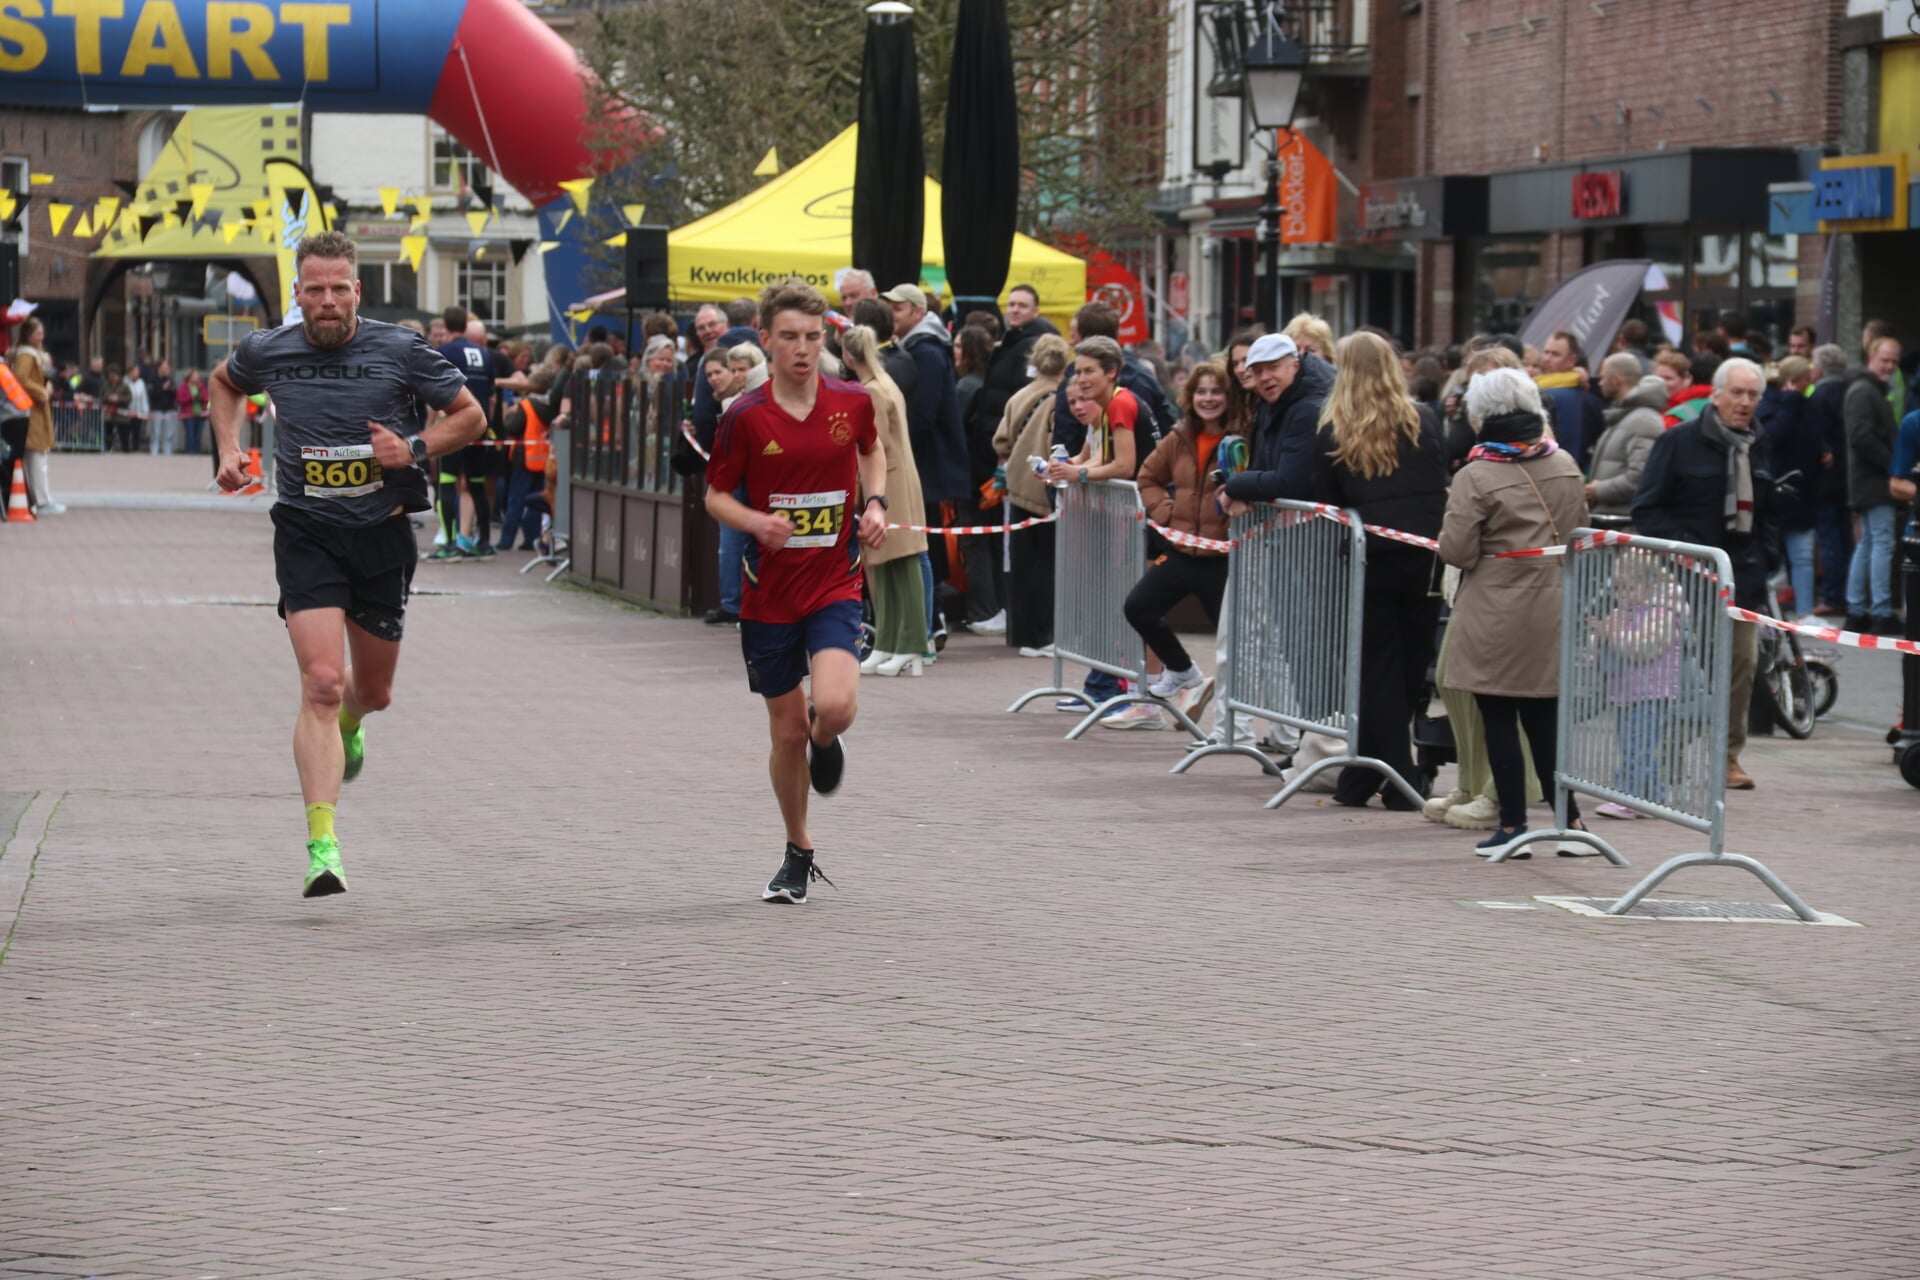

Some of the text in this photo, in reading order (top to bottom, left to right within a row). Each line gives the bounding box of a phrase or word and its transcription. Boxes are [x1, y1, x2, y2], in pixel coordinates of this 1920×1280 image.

[0, 0, 351, 82] START
[275, 364, 383, 380] ROGUE
[305, 461, 368, 487] 860
